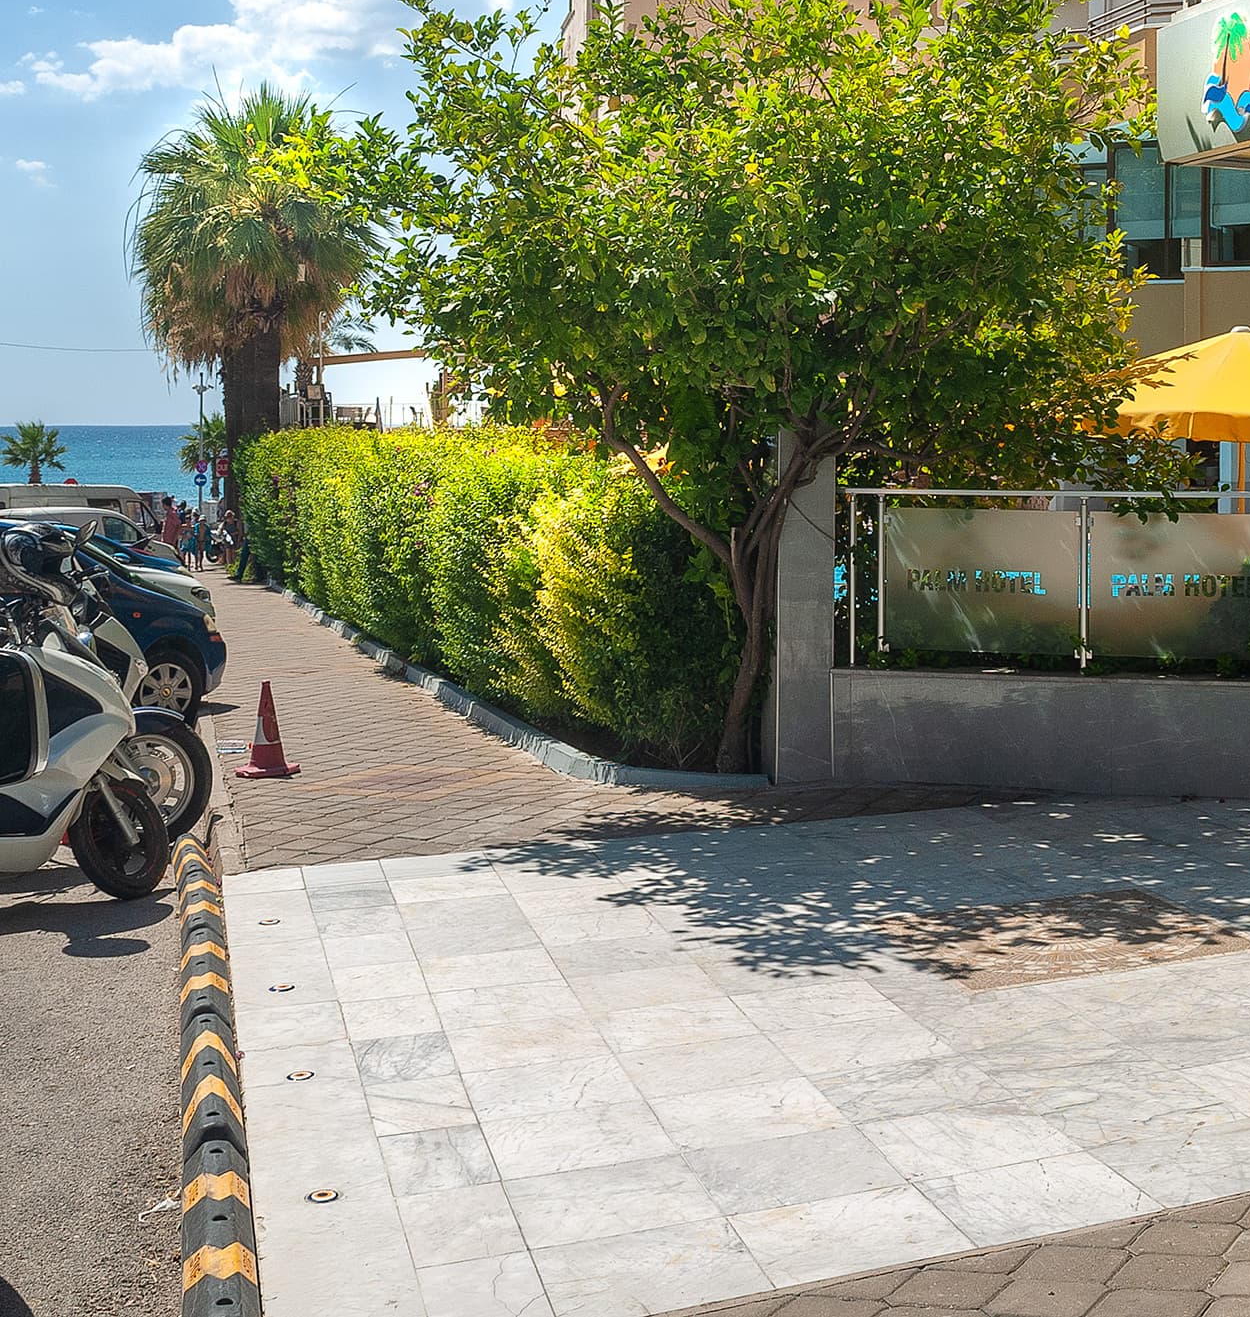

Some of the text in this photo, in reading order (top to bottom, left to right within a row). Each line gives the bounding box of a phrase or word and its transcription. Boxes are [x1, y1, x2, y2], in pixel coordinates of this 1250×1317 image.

[906, 568, 1047, 595] PALM HOTEL
[1111, 573, 1175, 597] PALM
